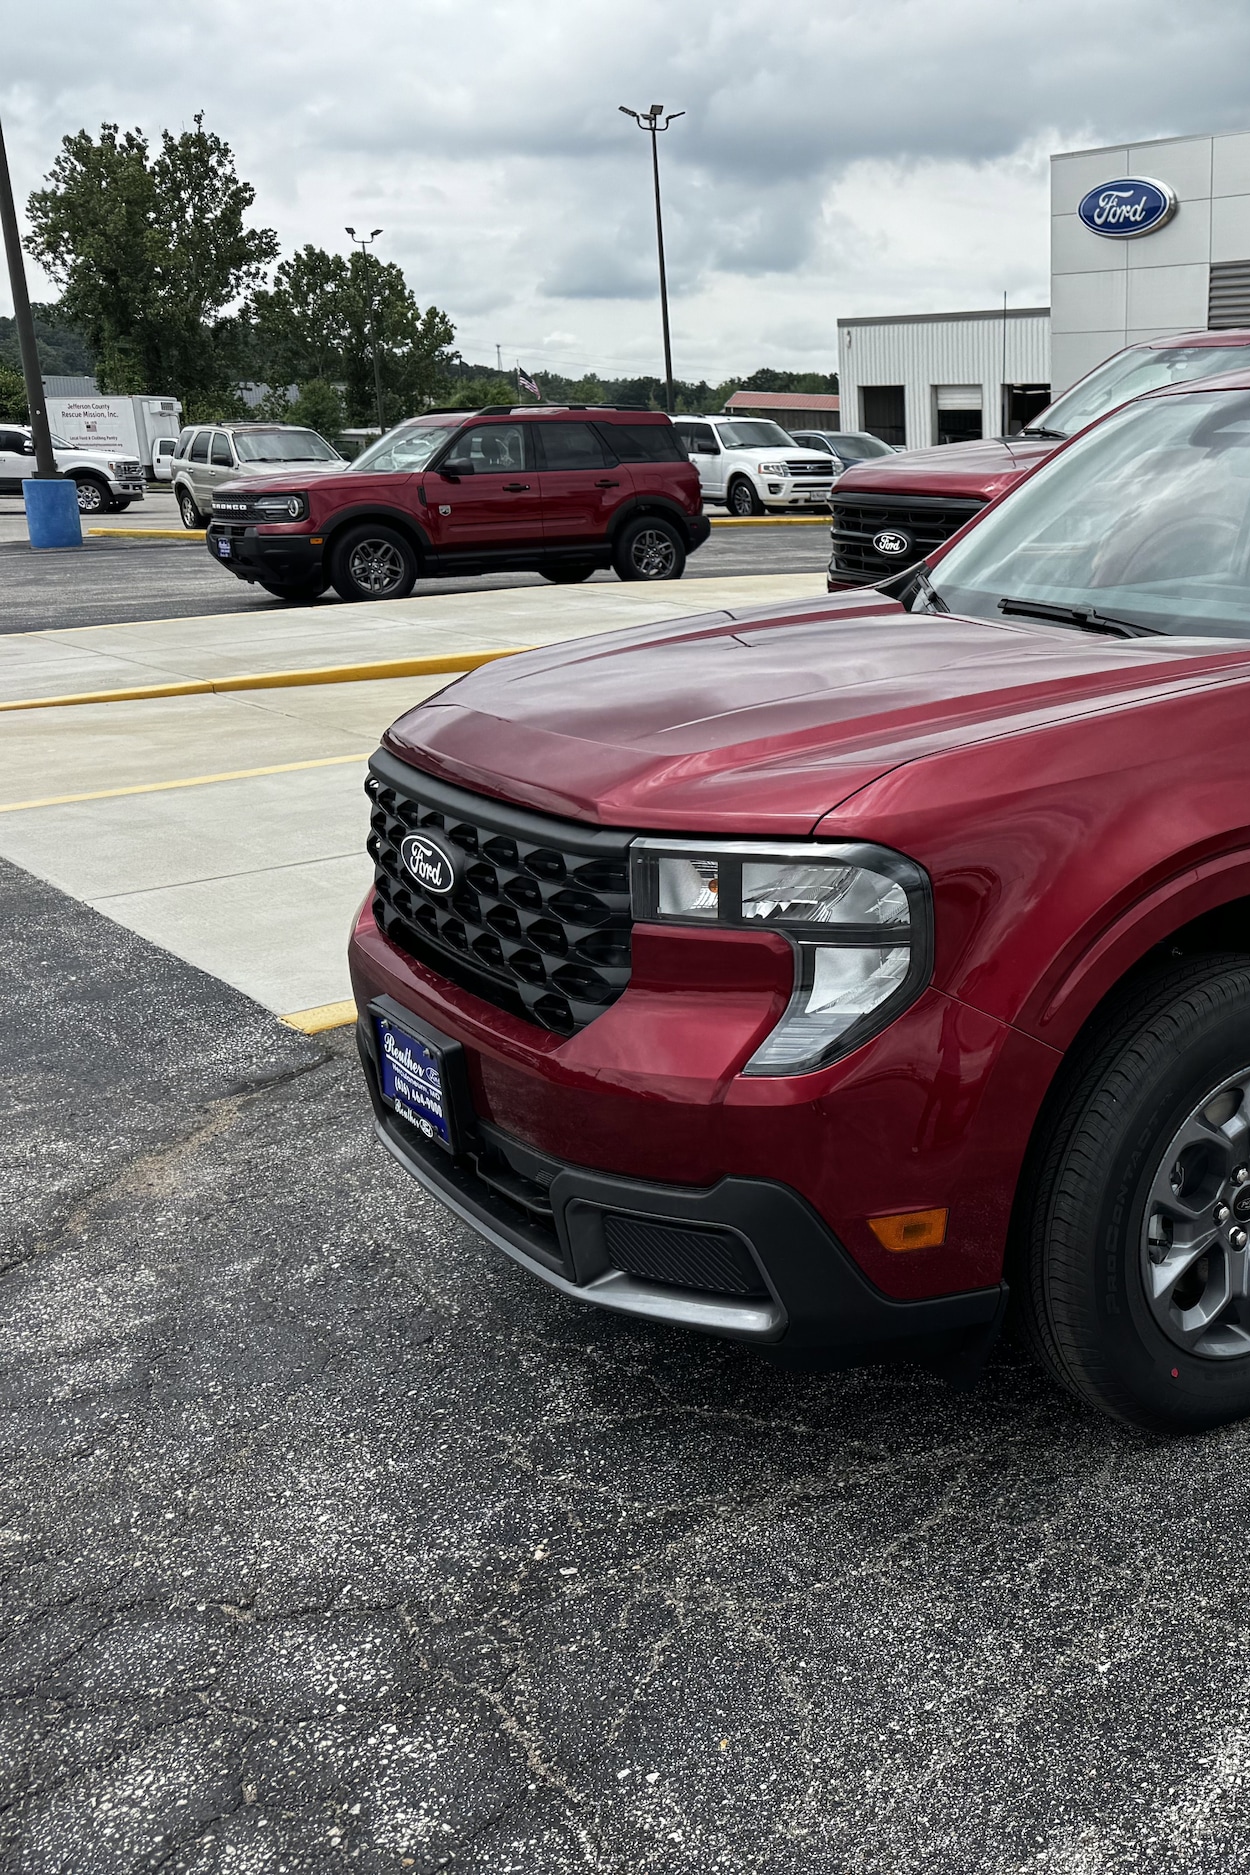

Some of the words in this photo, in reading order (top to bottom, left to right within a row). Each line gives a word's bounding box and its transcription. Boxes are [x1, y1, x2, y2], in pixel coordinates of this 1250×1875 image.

[1093, 189, 1148, 226] Ford
[879, 535, 901, 551] Ford
[410, 841, 442, 886] Ford
[384, 1032, 425, 1077] Reuther
